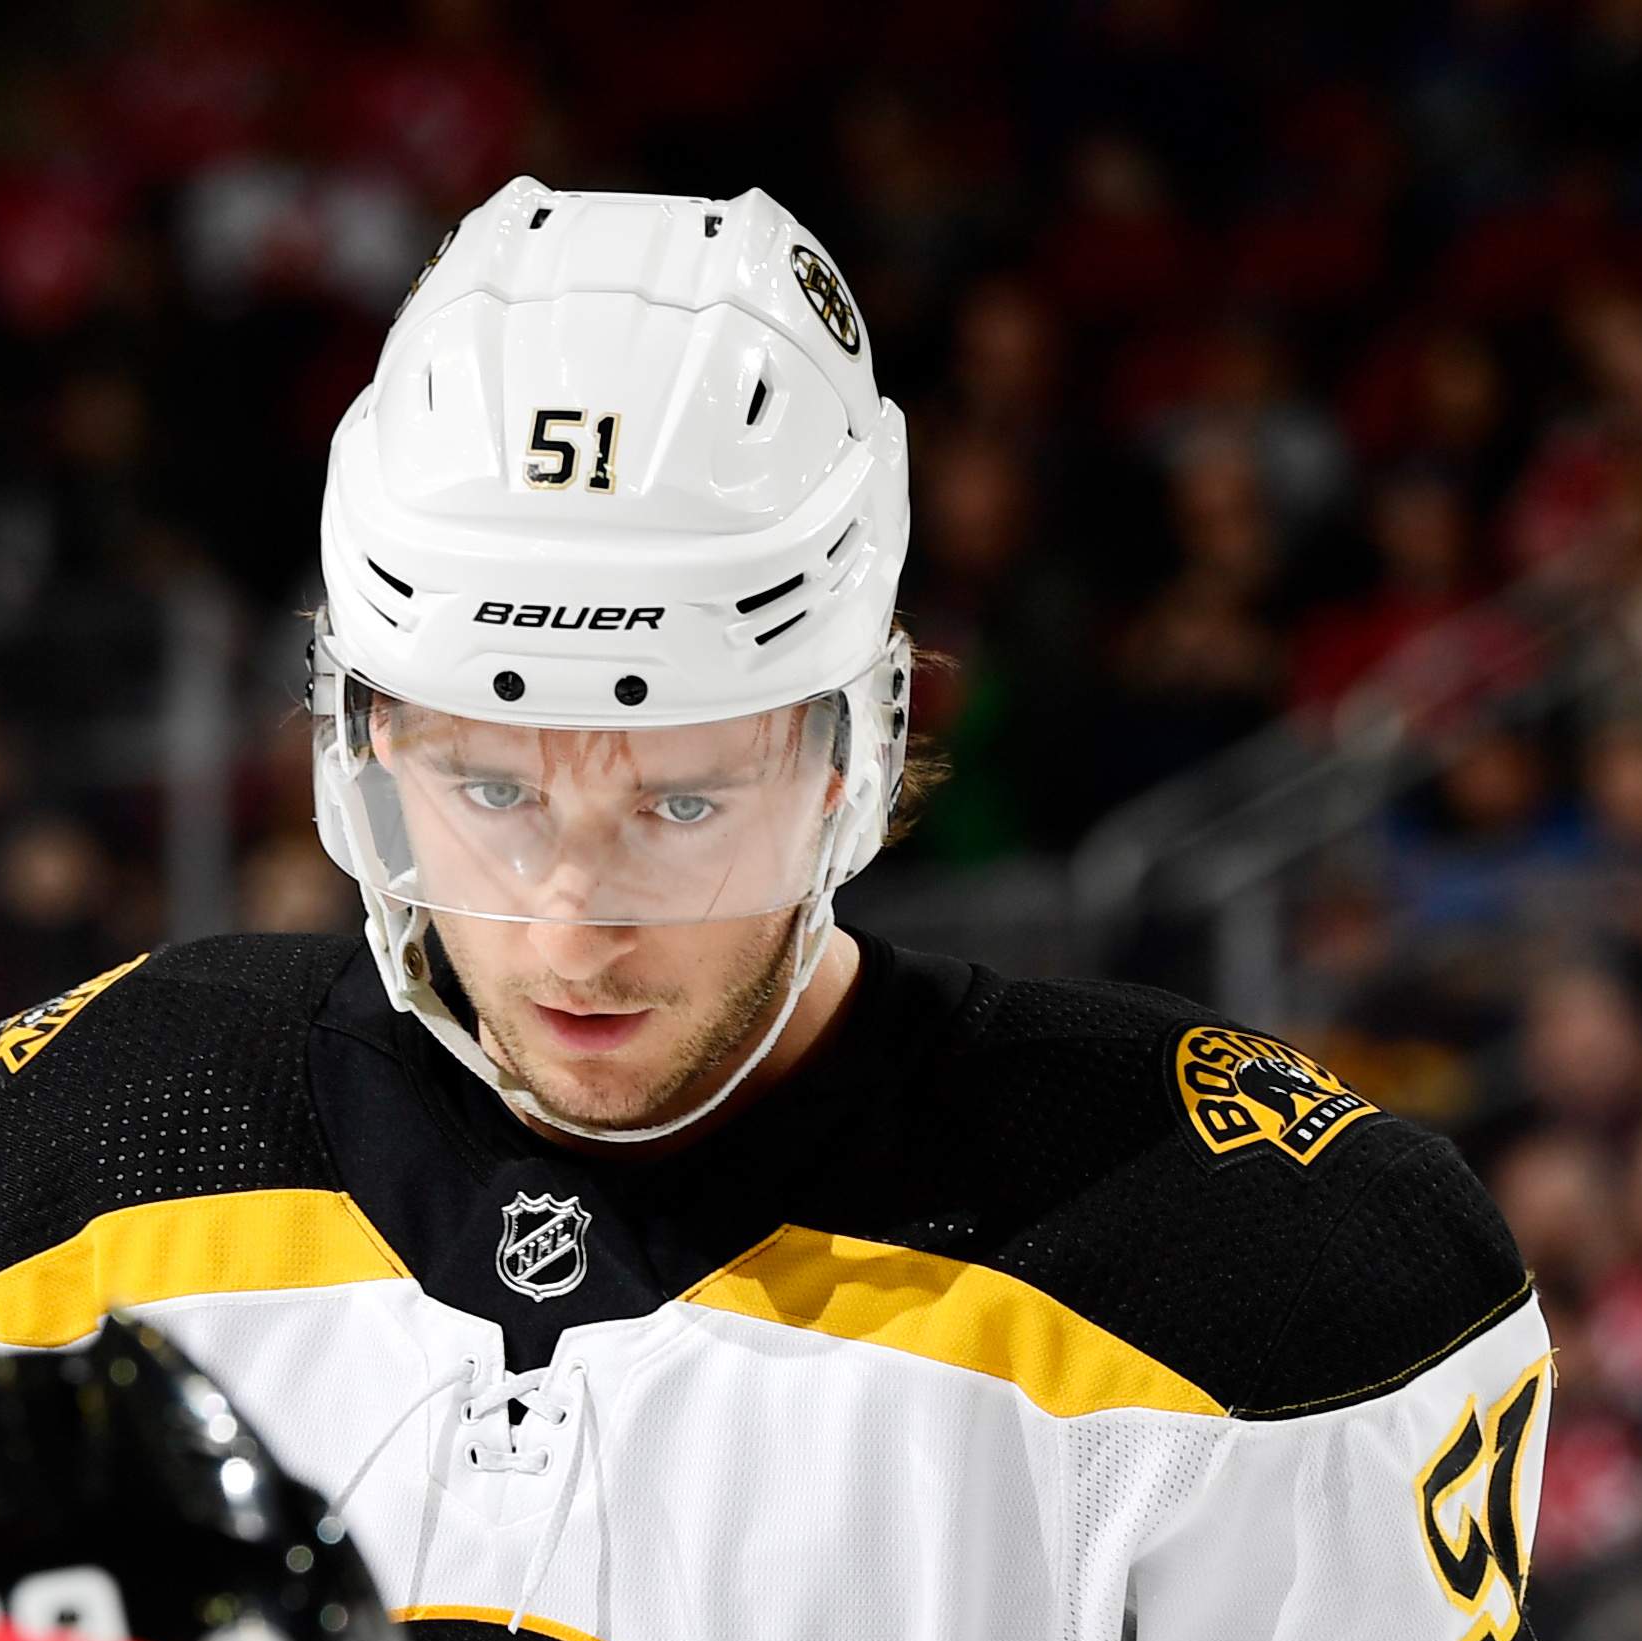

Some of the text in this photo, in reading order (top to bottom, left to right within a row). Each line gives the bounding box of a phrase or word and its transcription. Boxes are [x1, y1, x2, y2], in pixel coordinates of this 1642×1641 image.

[522, 407, 622, 495] 51
[472, 601, 666, 631] BAUER
[516, 1222, 572, 1275] NHL
